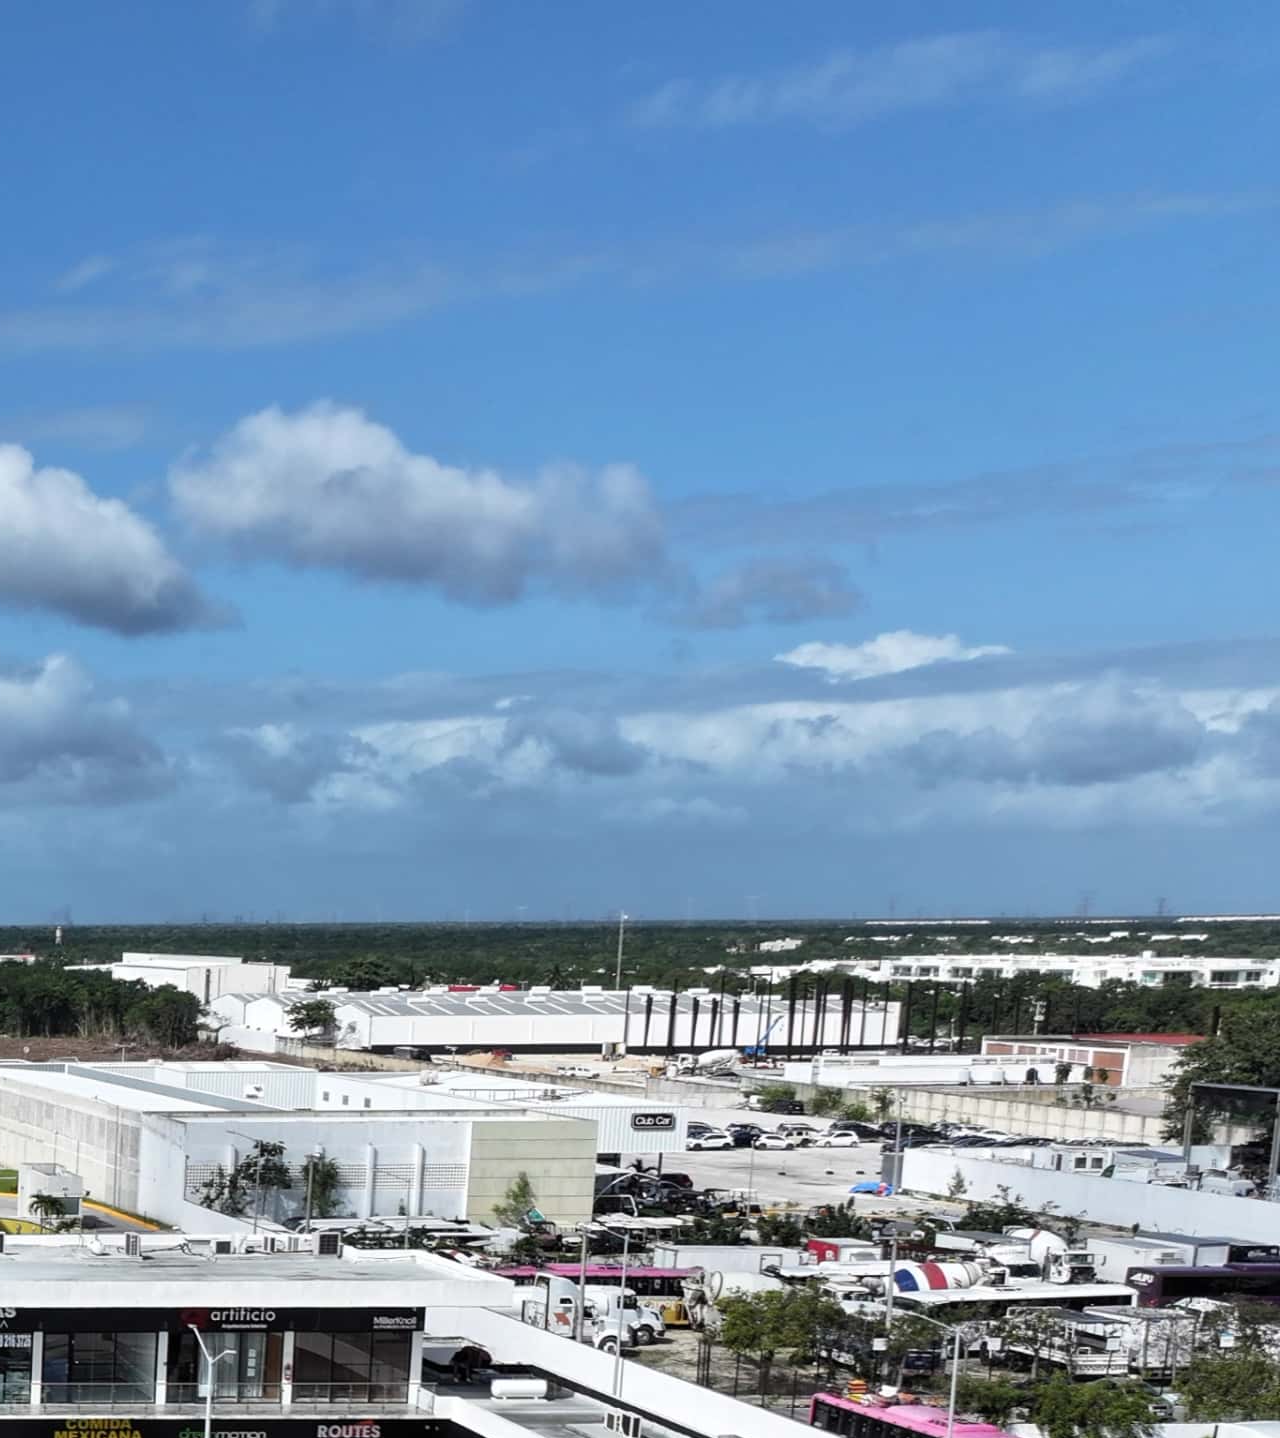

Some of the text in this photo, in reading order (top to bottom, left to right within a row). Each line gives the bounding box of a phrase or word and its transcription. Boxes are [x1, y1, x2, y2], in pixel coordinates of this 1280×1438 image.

[635, 1116, 673, 1125] Club Car
[65, 1419, 133, 1430] COMIDA
[317, 1425, 381, 1438] ROUTES
